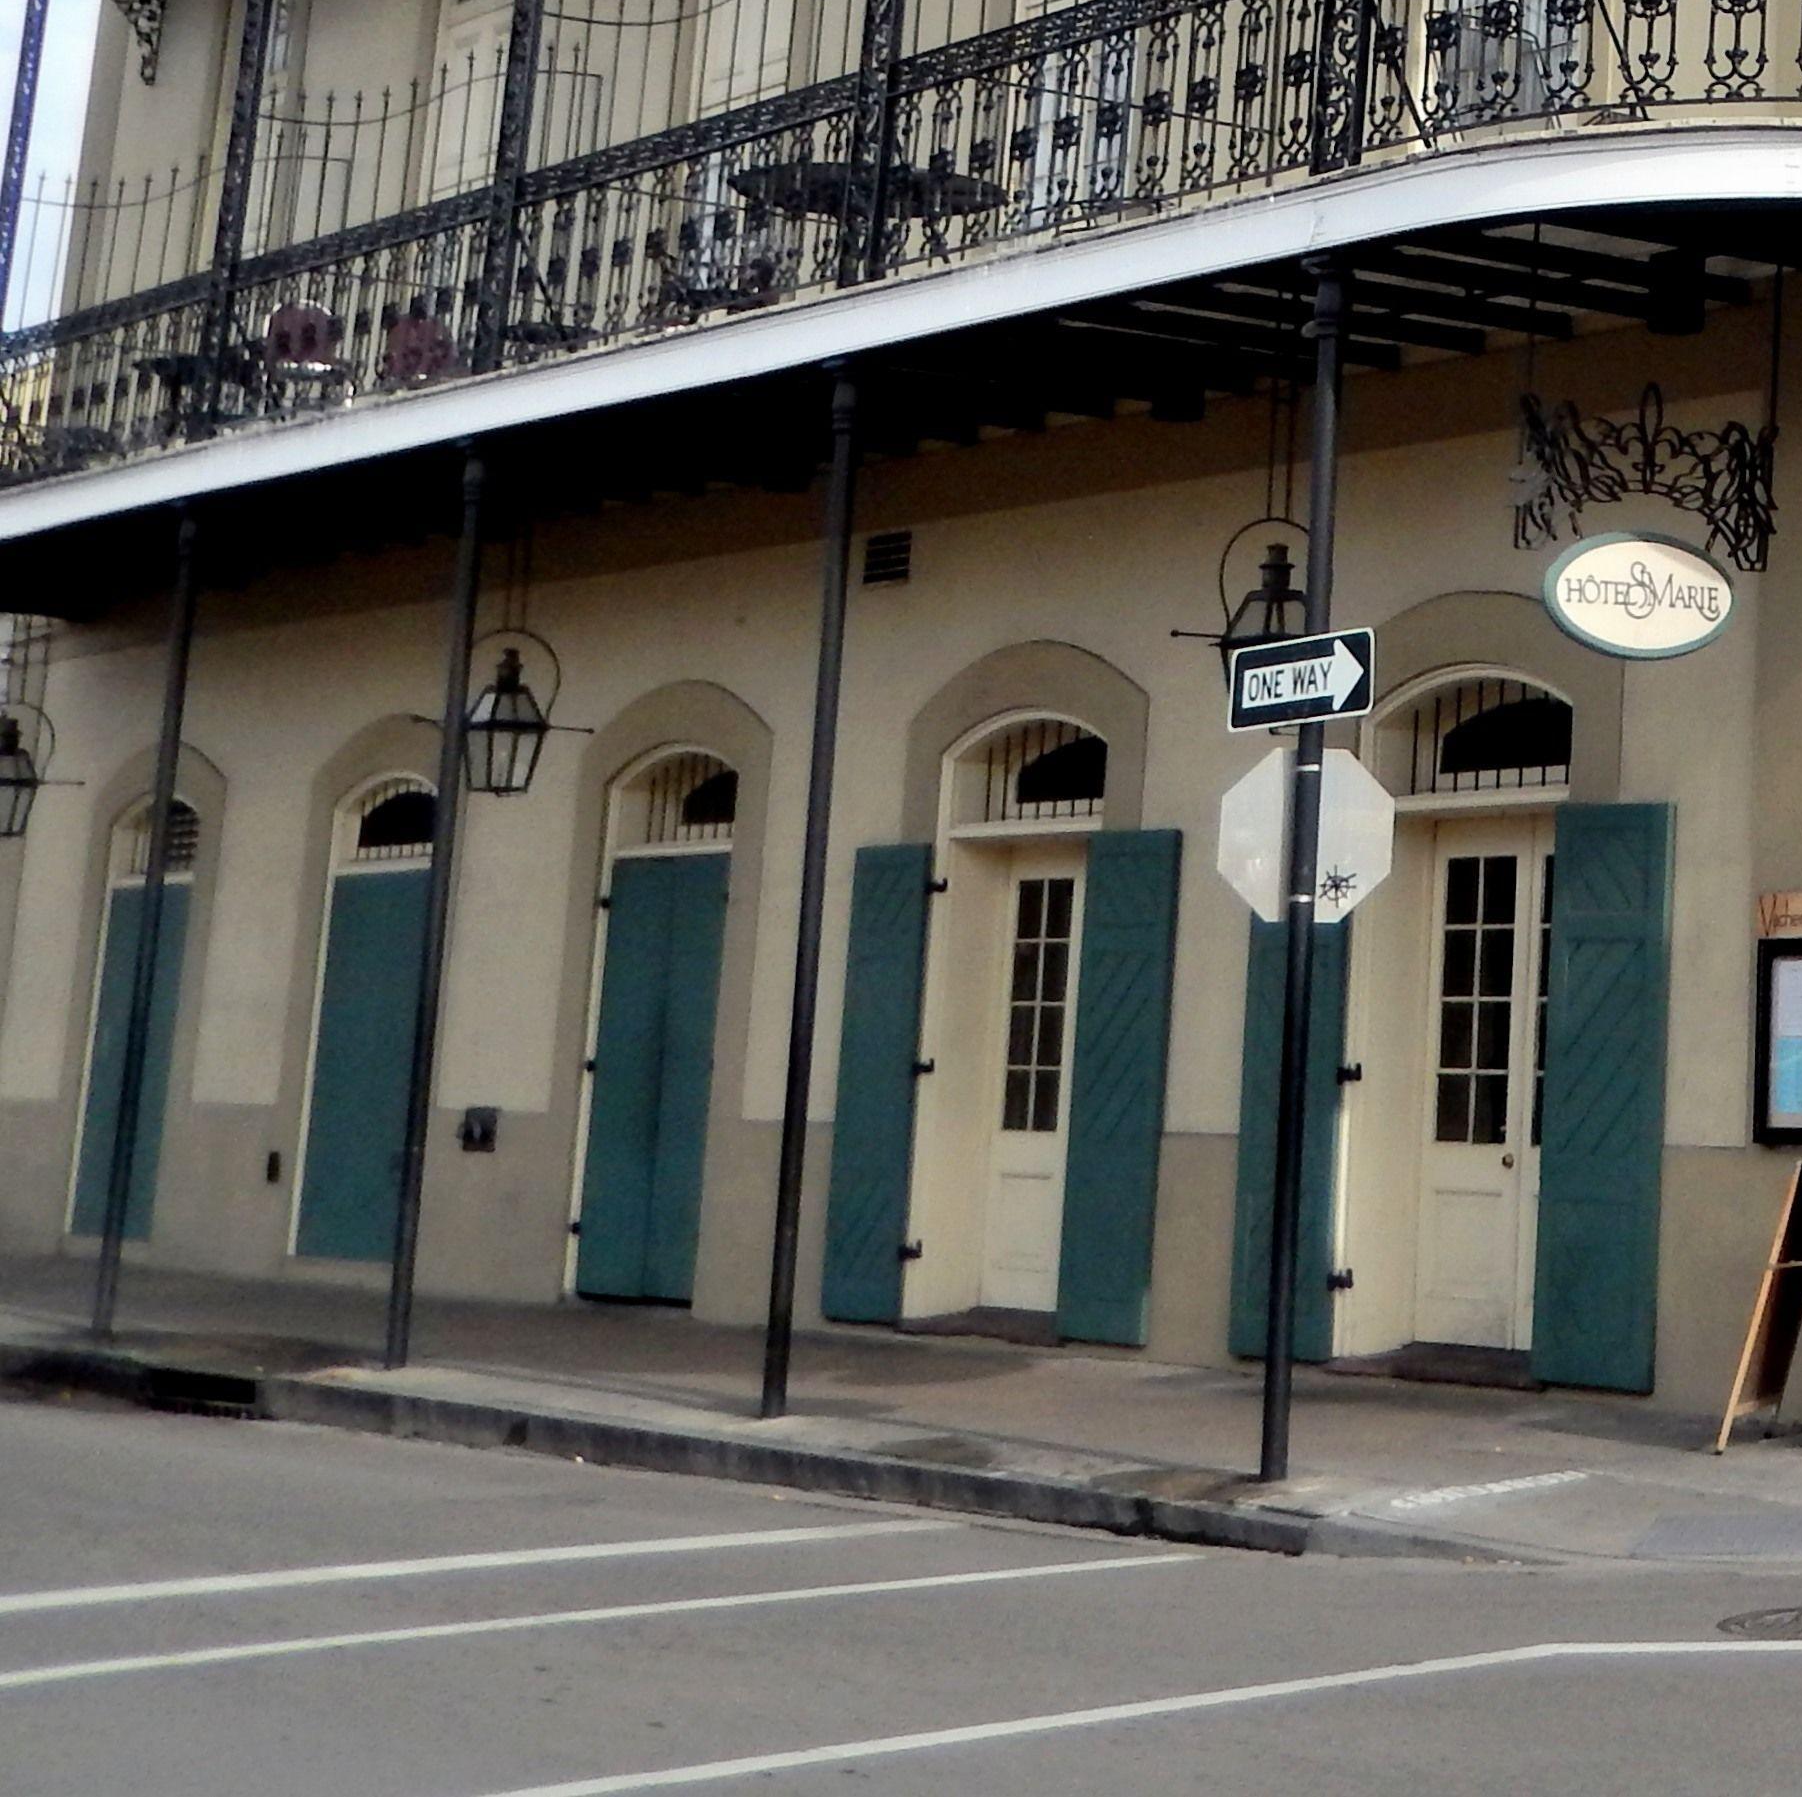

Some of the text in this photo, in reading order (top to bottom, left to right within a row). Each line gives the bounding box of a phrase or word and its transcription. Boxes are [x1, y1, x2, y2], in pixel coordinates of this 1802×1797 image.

[1645, 571, 1721, 621] MARIE
[1248, 661, 1332, 701] ONE WAY
